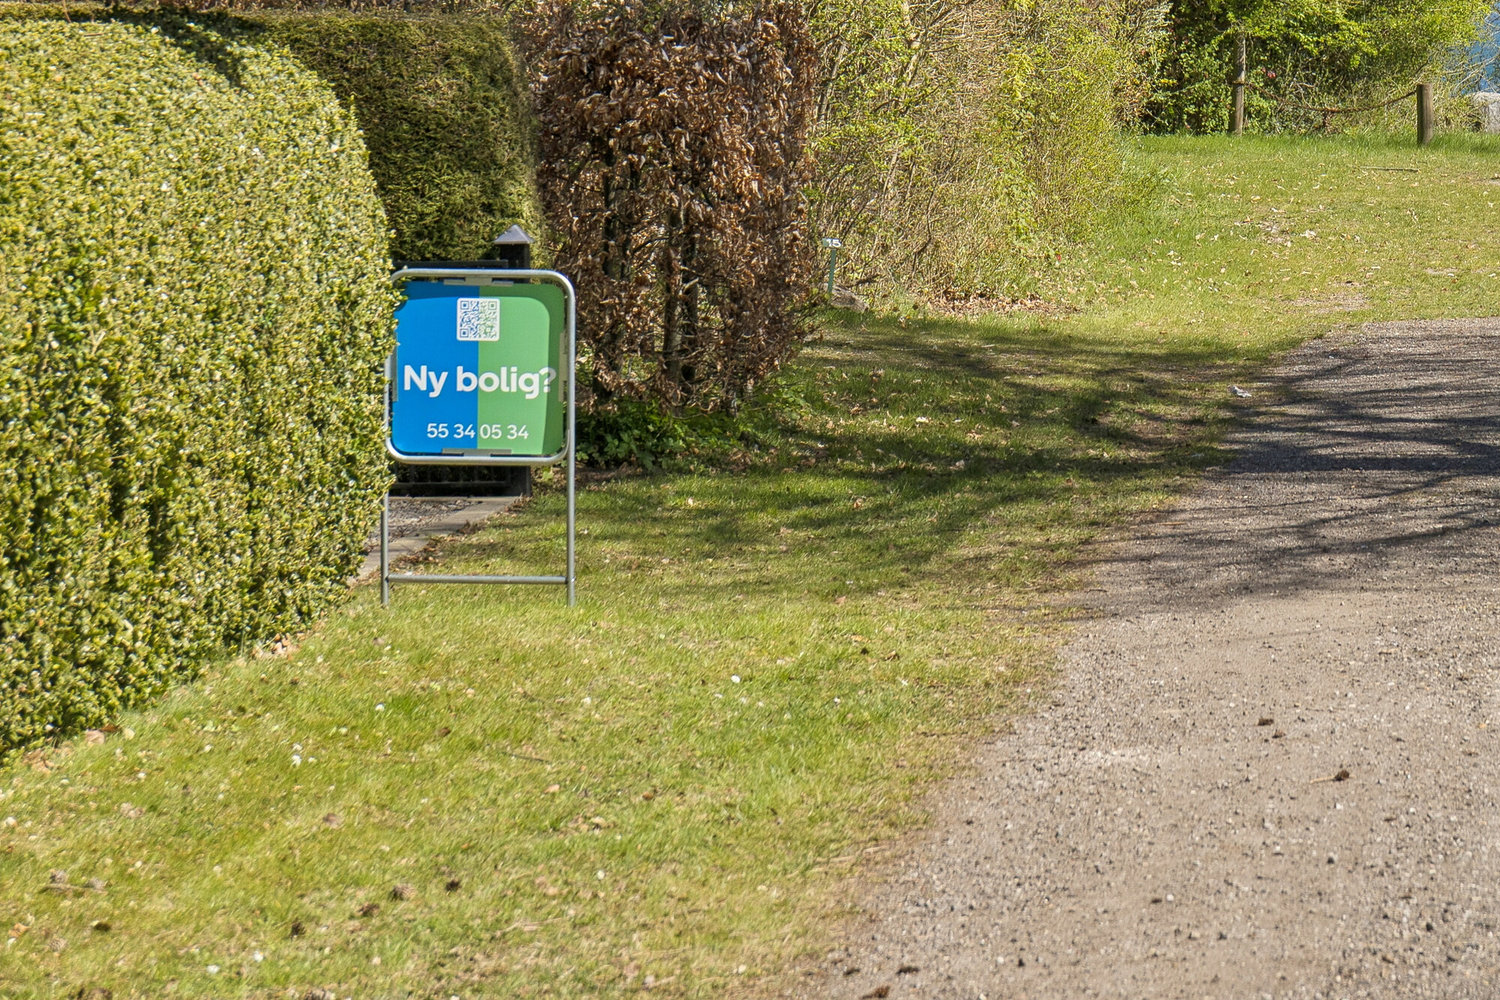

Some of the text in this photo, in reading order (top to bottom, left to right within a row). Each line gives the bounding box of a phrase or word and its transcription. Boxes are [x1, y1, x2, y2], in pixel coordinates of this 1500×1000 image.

[403, 364, 557, 400] Ny bolig?
[426, 422, 529, 440] 55 34 05 34
